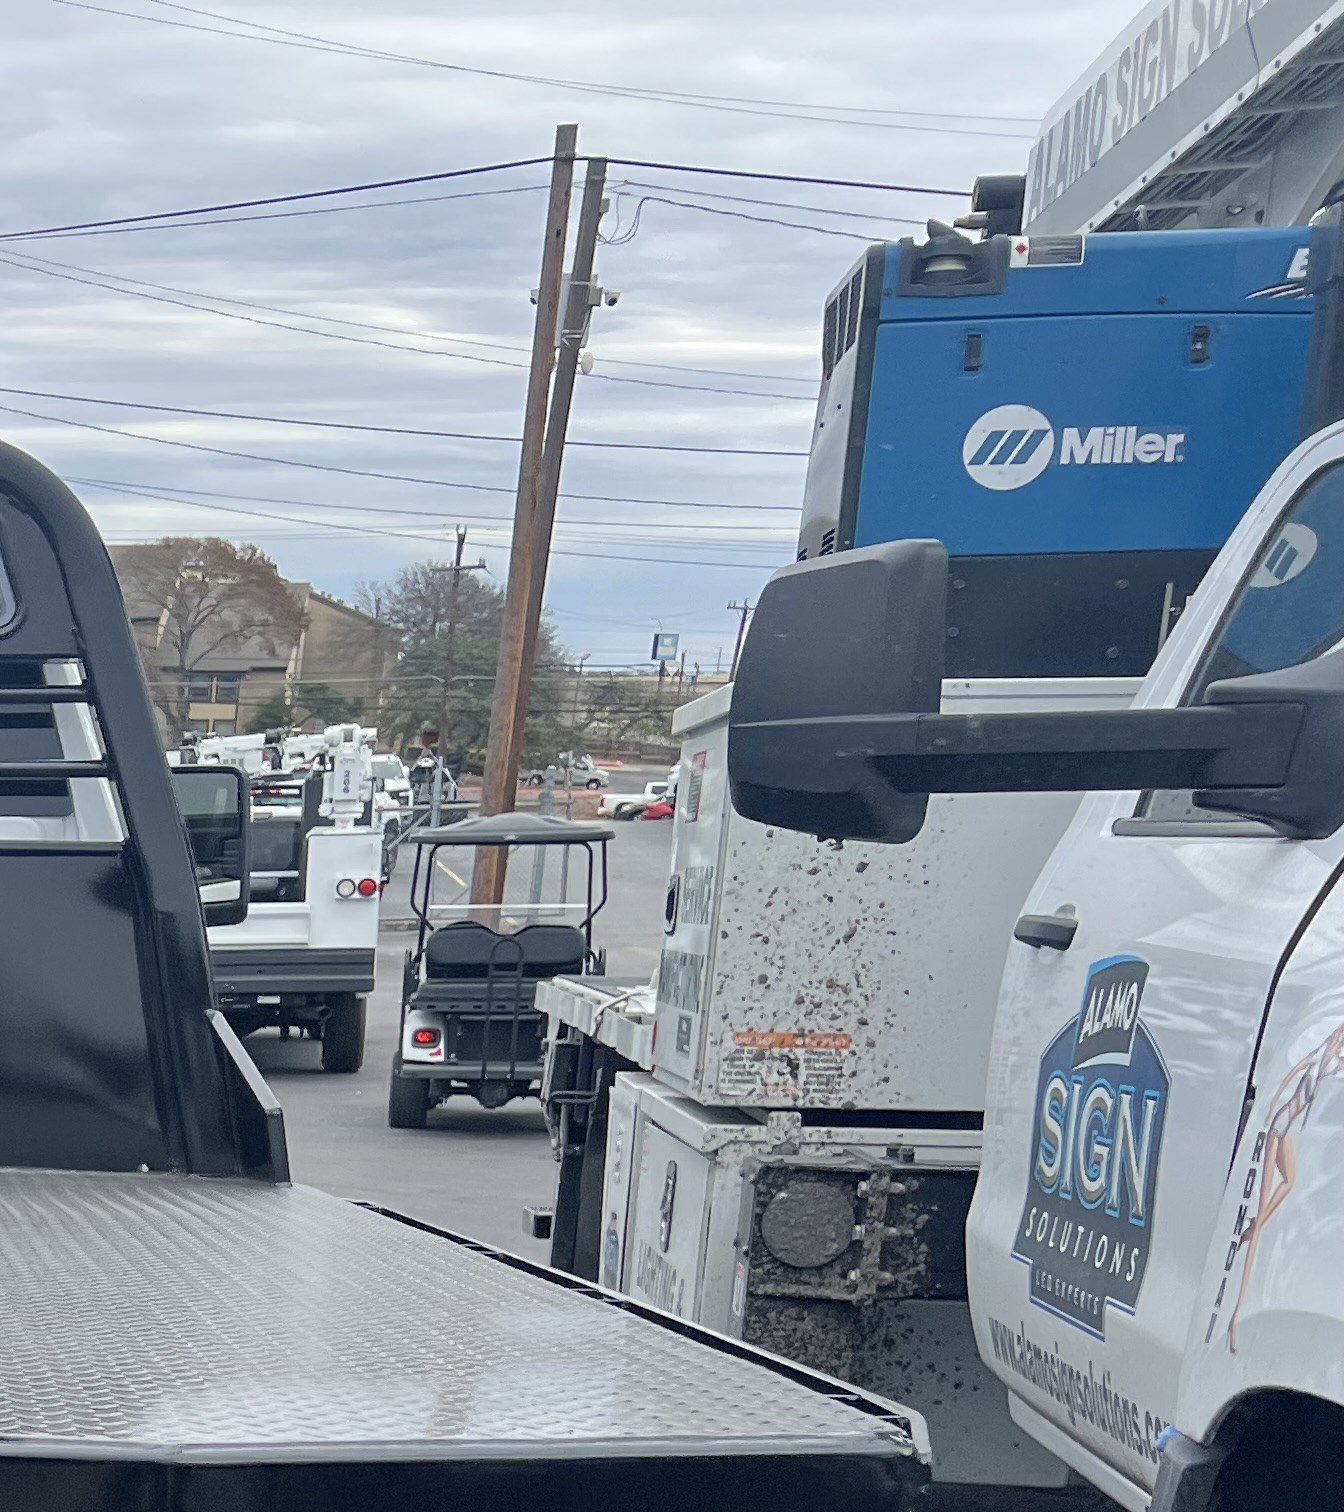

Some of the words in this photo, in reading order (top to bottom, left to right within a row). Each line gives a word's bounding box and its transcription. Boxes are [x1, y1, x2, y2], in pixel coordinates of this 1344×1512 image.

[1026, 72, 1108, 230] ALAMO
[1059, 426, 1184, 465] Miller
[1079, 981, 1139, 1044] ALAMO
[1034, 1069, 1161, 1227] SIGN
[1025, 1207, 1140, 1283] SOLUTIONS
[988, 1317, 1170, 1464] www.alamosignsolutions.co
